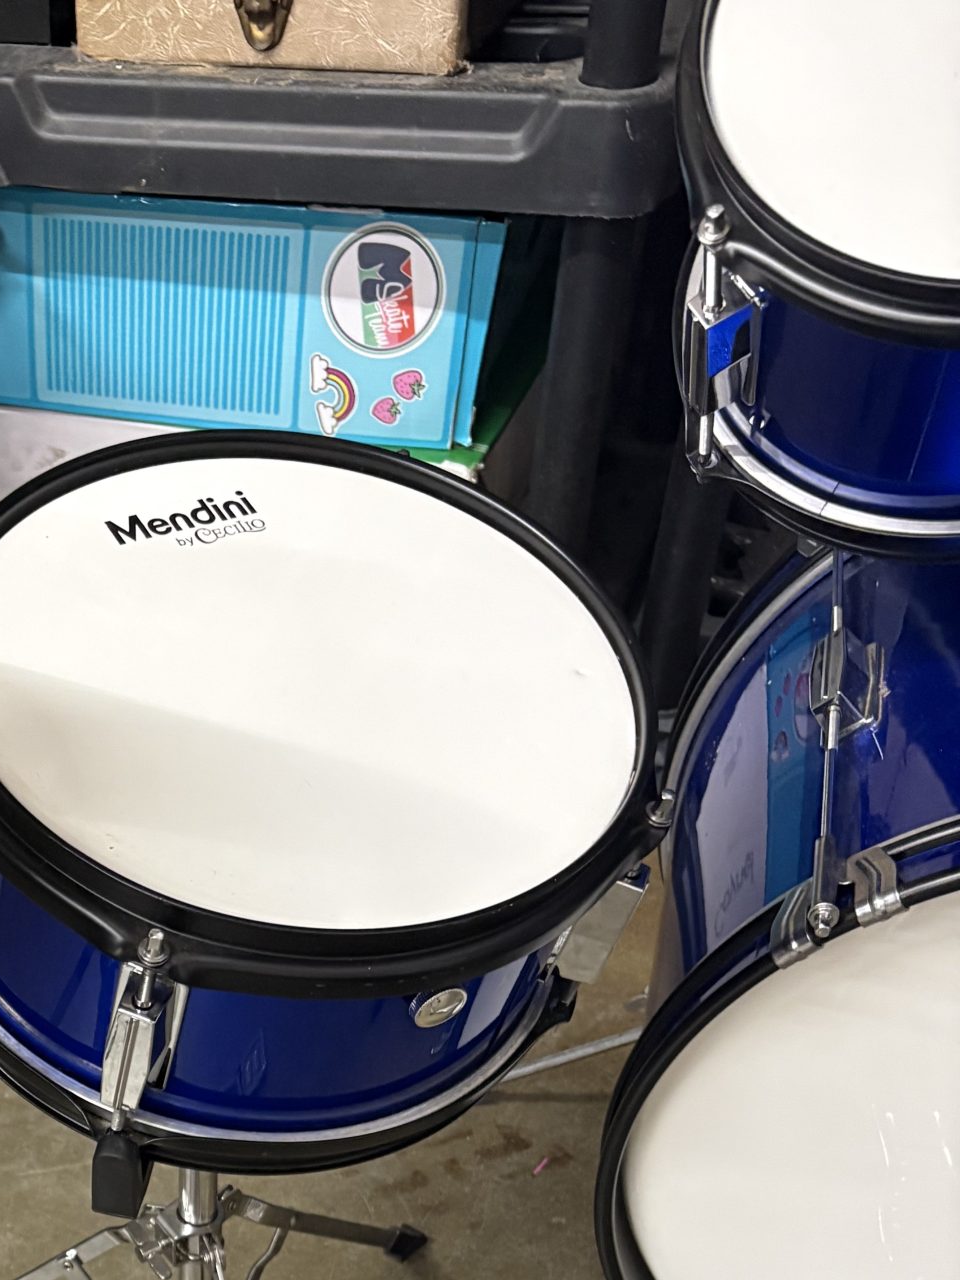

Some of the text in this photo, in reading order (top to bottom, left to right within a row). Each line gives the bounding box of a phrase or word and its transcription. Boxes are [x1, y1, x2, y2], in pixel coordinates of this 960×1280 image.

[365, 302, 390, 347] Team
[375, 281, 410, 334] Skate
[104, 490, 258, 546] Mendini
[175, 536, 195, 547] by
